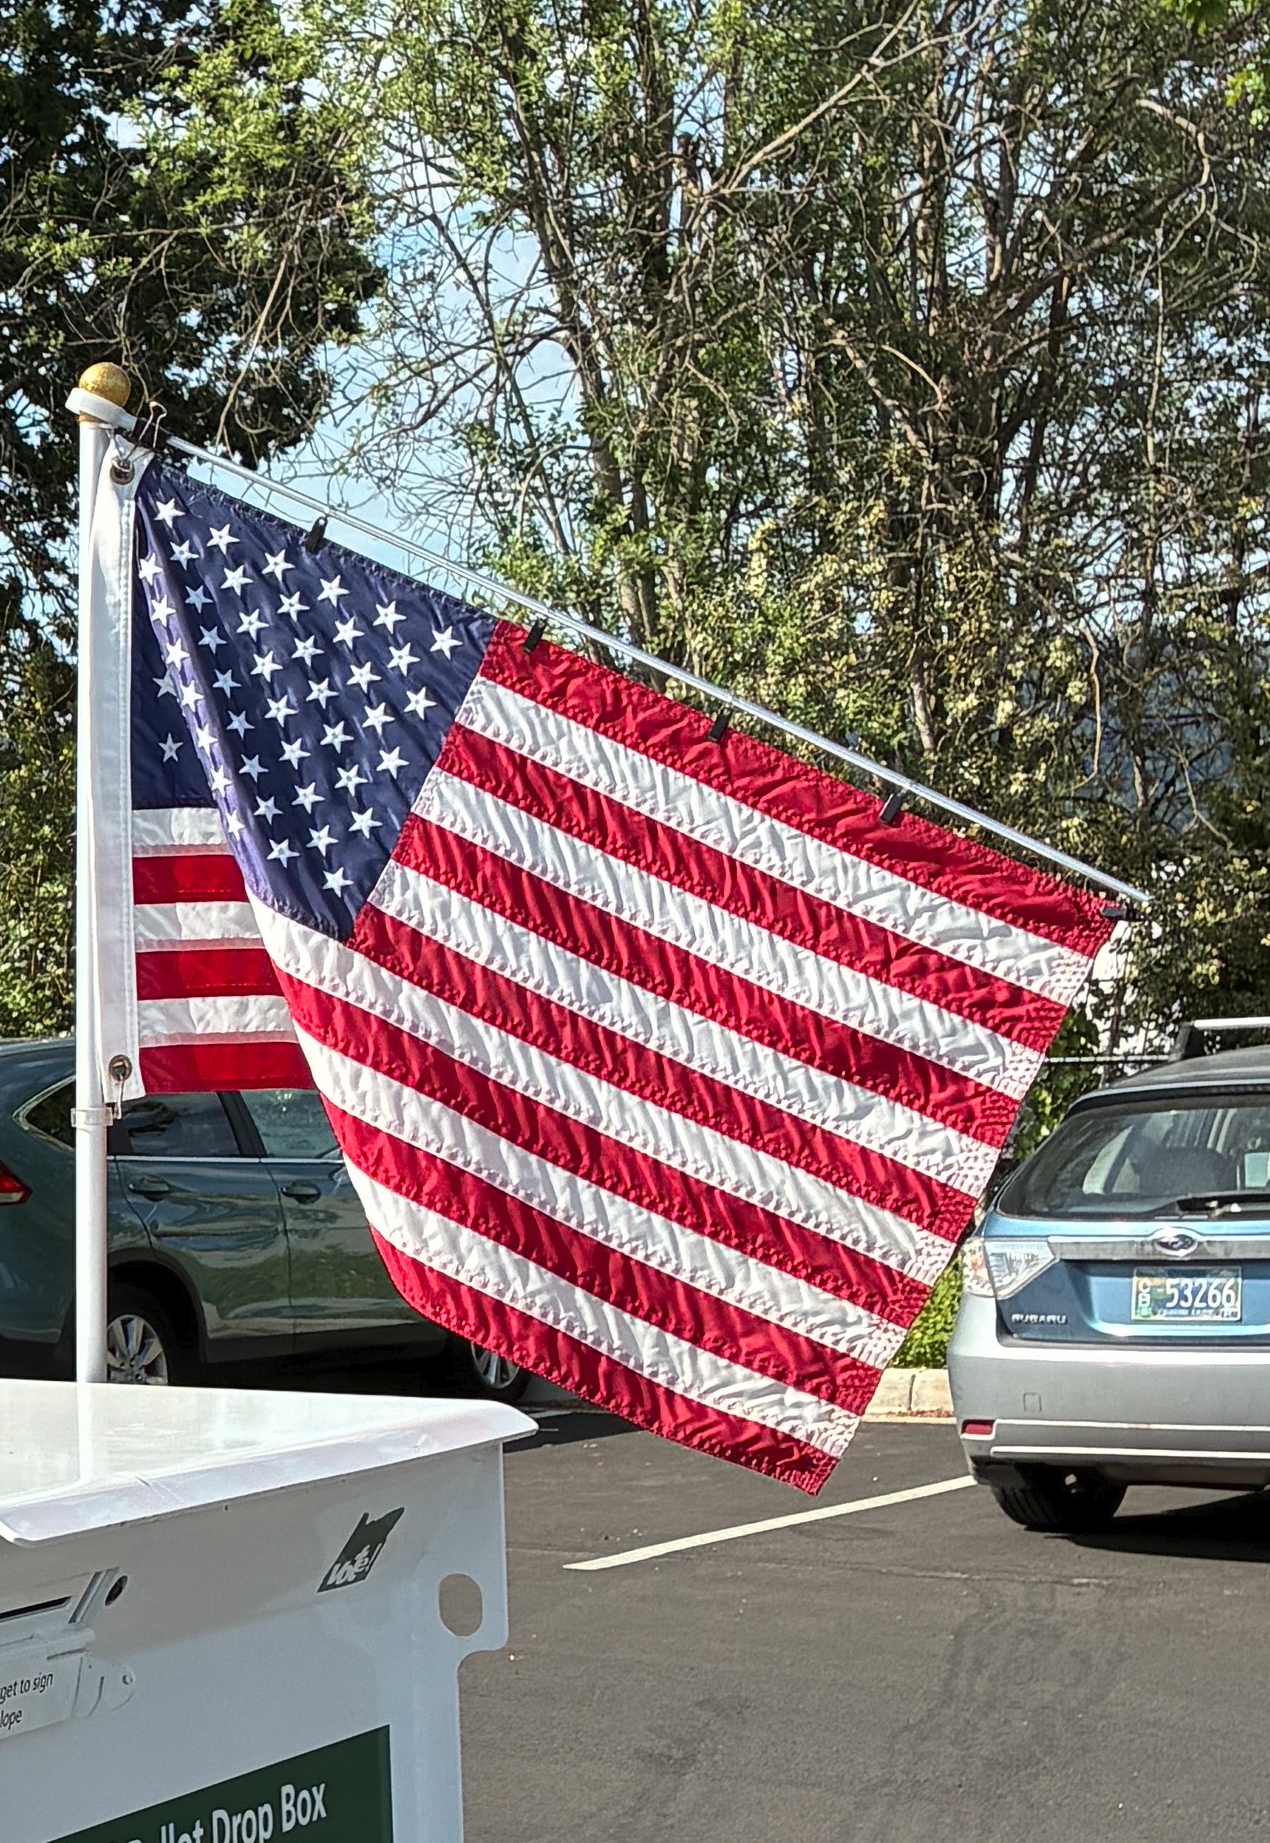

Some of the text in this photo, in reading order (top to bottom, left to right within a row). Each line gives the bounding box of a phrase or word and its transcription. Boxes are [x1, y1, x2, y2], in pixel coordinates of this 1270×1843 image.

[1165, 1278, 1236, 1308] 53266
[1011, 1313, 1068, 1324] SUBARU
[20, 1679, 31, 1694] to
[32, 1672, 54, 1693] sign
[281, 1781, 327, 1833] Box
